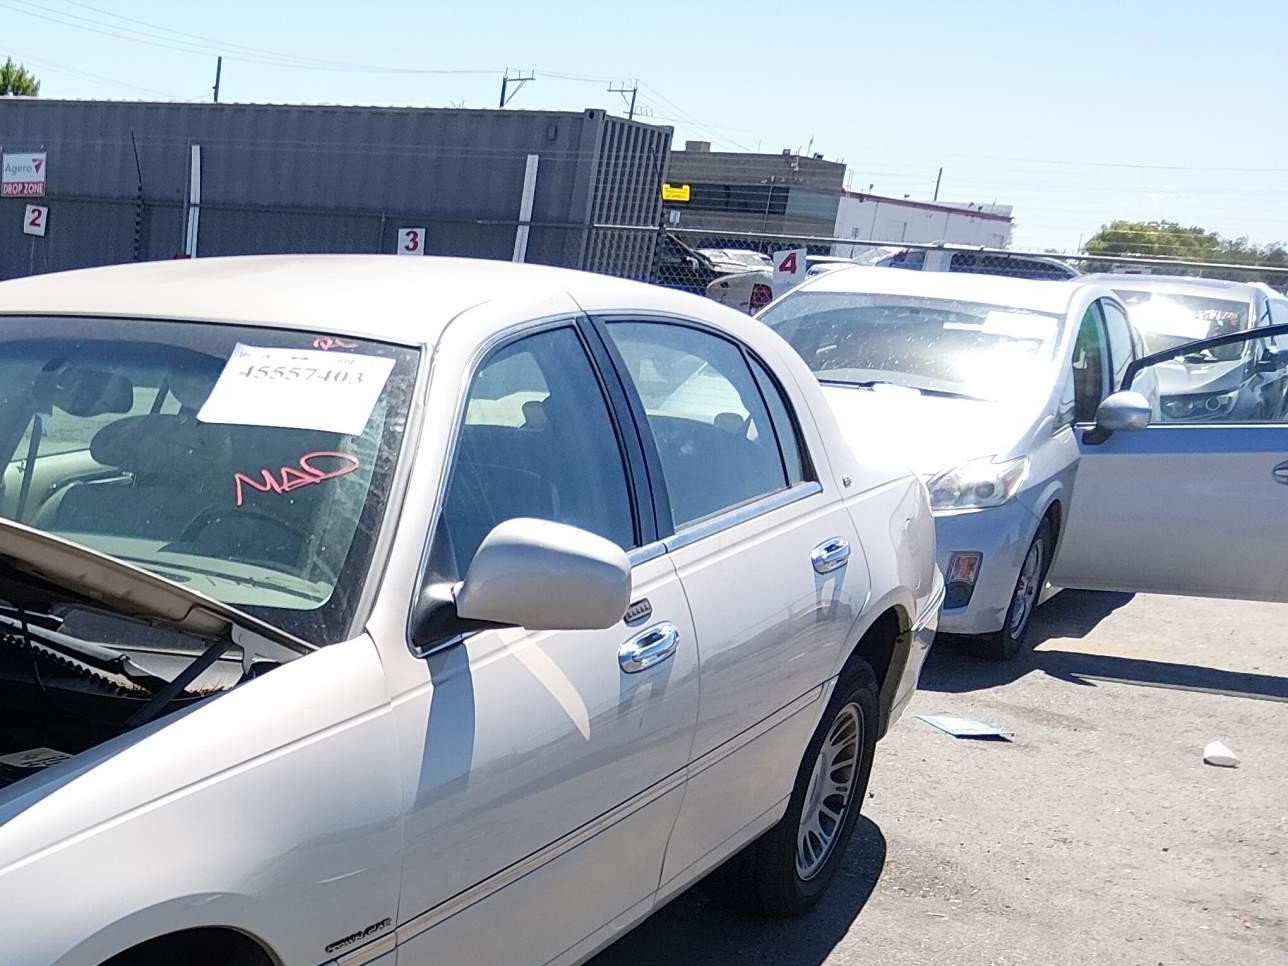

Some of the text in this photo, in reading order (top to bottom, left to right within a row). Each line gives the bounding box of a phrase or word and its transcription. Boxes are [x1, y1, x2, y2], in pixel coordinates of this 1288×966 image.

[5, 163, 32, 176] Agero
[3, 183, 44, 194] DROP ZONE
[28, 208, 42, 228] 2
[404, 230, 419, 252] 3
[779, 252, 797, 274] 4
[238, 364, 365, 385] 45557403
